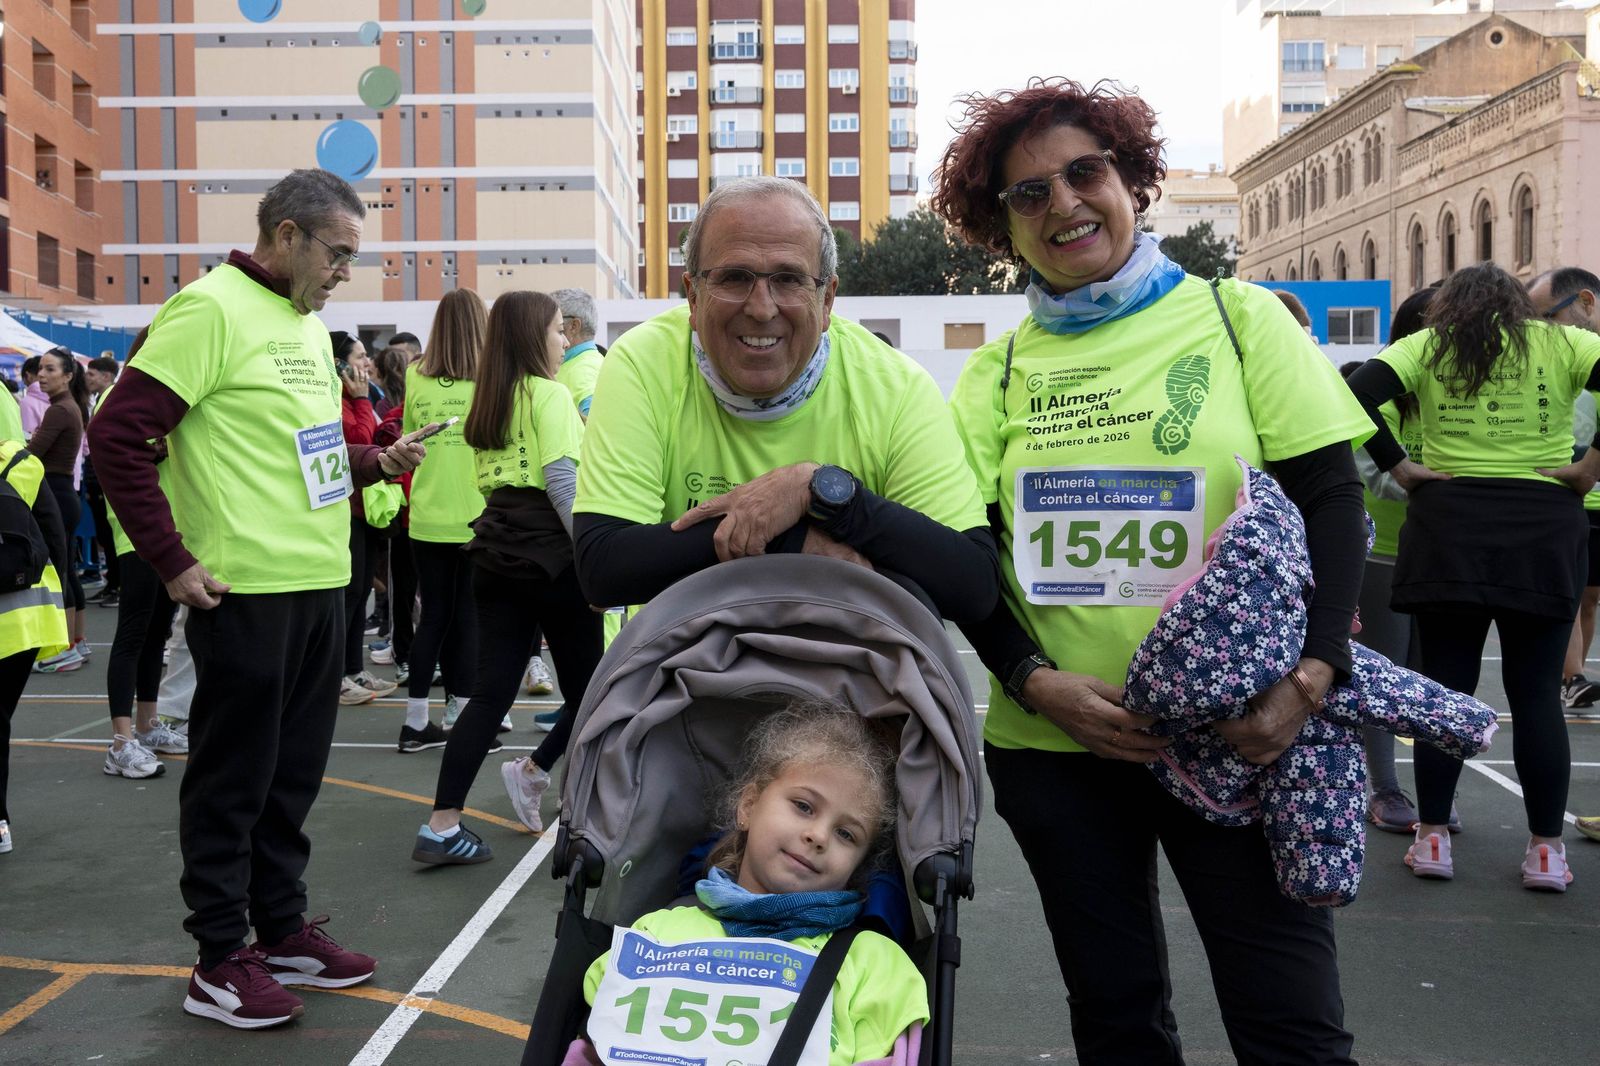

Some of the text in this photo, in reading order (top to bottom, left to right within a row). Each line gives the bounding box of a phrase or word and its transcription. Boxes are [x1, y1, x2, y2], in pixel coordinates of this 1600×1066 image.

[274, 358, 283, 367] II
[291, 368, 315, 376] marcha
[1049, 367, 1081, 375] asociación
[282, 377, 305, 385] contra
[1030, 387, 1122, 413] II Almería
[1448, 403, 1476, 411] cajamar
[1028, 402, 1110, 423] en marcha
[1026, 410, 1154, 436] contra el cáncer
[308, 439, 330, 450] contra
[330, 435, 337, 444] el
[1033, 442, 1043, 451] de
[1046, 438, 1084, 449] febrero
[1087, 435, 1100, 445] de
[1103, 431, 1131, 443] 2026
[1034, 475, 1178, 490] II Almería en marcha
[1039, 492, 1082, 505] contra
[1086, 491, 1100, 504] el
[1103, 491, 1155, 504] cáncer
[1029, 519, 1189, 570] 1549
[1036, 585, 1102, 593] #TodosContraElCáncer
[635, 942, 803, 971] II Almería en marcha
[635, 961, 690, 976] contra
[695, 961, 712, 975] el
[716, 963, 777, 980] cáncer
[781, 979, 797, 988] 2026
[614, 1050, 702, 1066] #TodosContraElCáncer
